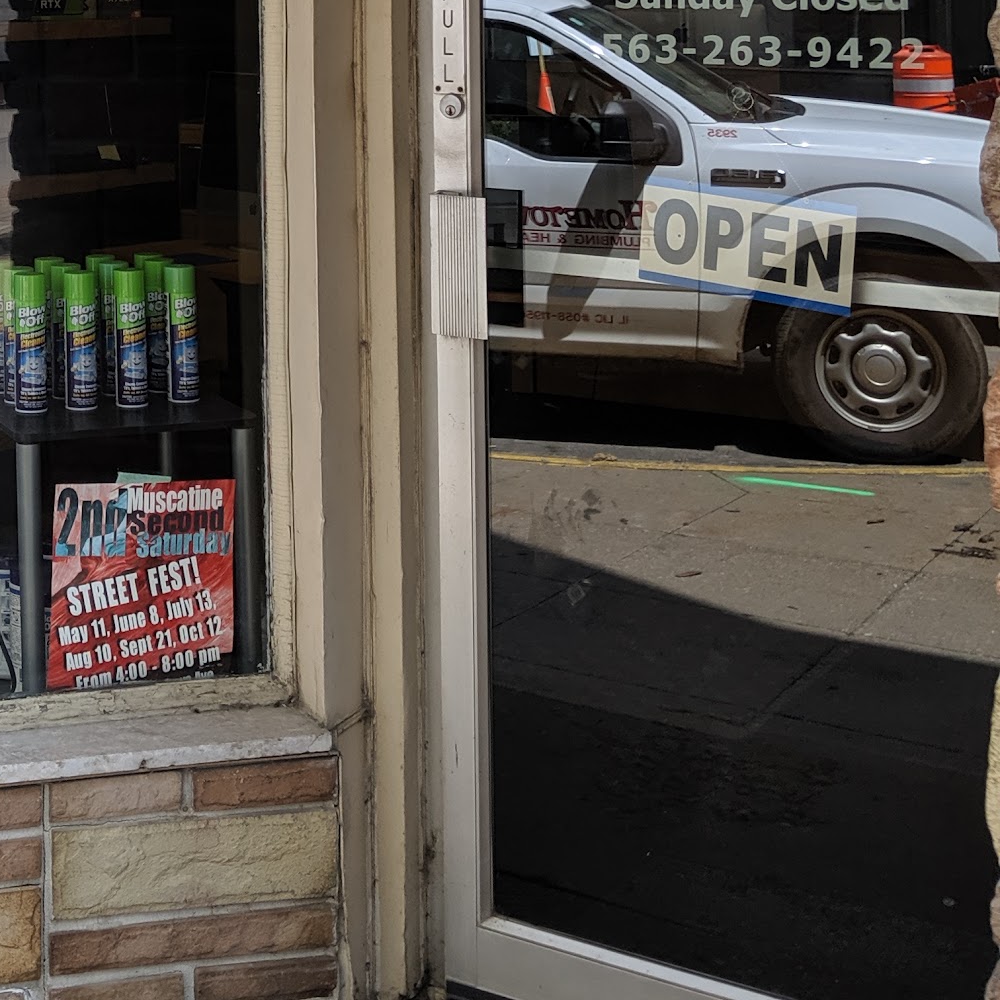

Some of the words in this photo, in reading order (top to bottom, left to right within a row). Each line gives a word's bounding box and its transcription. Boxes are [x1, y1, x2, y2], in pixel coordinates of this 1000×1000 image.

[40, 0, 62, 9] RTX
[602, 33, 926, 71] 563-263-9422
[653, 198, 844, 293] OPEN
[19, 305, 46, 318] Blow
[26, 314, 45, 327] Off
[69, 304, 96, 316] Blow
[78, 311, 95, 325] Off
[126, 485, 224, 514] Muscatine
[55, 486, 128, 557] 2nd
[129, 506, 225, 535] Second
[135, 527, 231, 558] Saturday
[66, 571, 140, 617] STREET
[147, 556, 201, 598] FEST!
[58, 623, 90, 647] May
[91, 618, 111, 639] 11,
[113, 612, 147, 633] June
[148, 605, 165, 626] 8,
[166, 598, 196, 621] July
[196, 590, 217, 611] 13,
[65, 650, 93, 672] Aug
[94, 642, 117, 663] 10,
[119, 635, 154, 659] Sept
[156, 628, 177, 649] 21,
[178, 624, 205, 642] Oct
[206, 614, 223, 635] 12
[115, 660, 148, 683] 4:00
[161, 649, 195, 673] 8:00
[198, 645, 221, 667] pm
